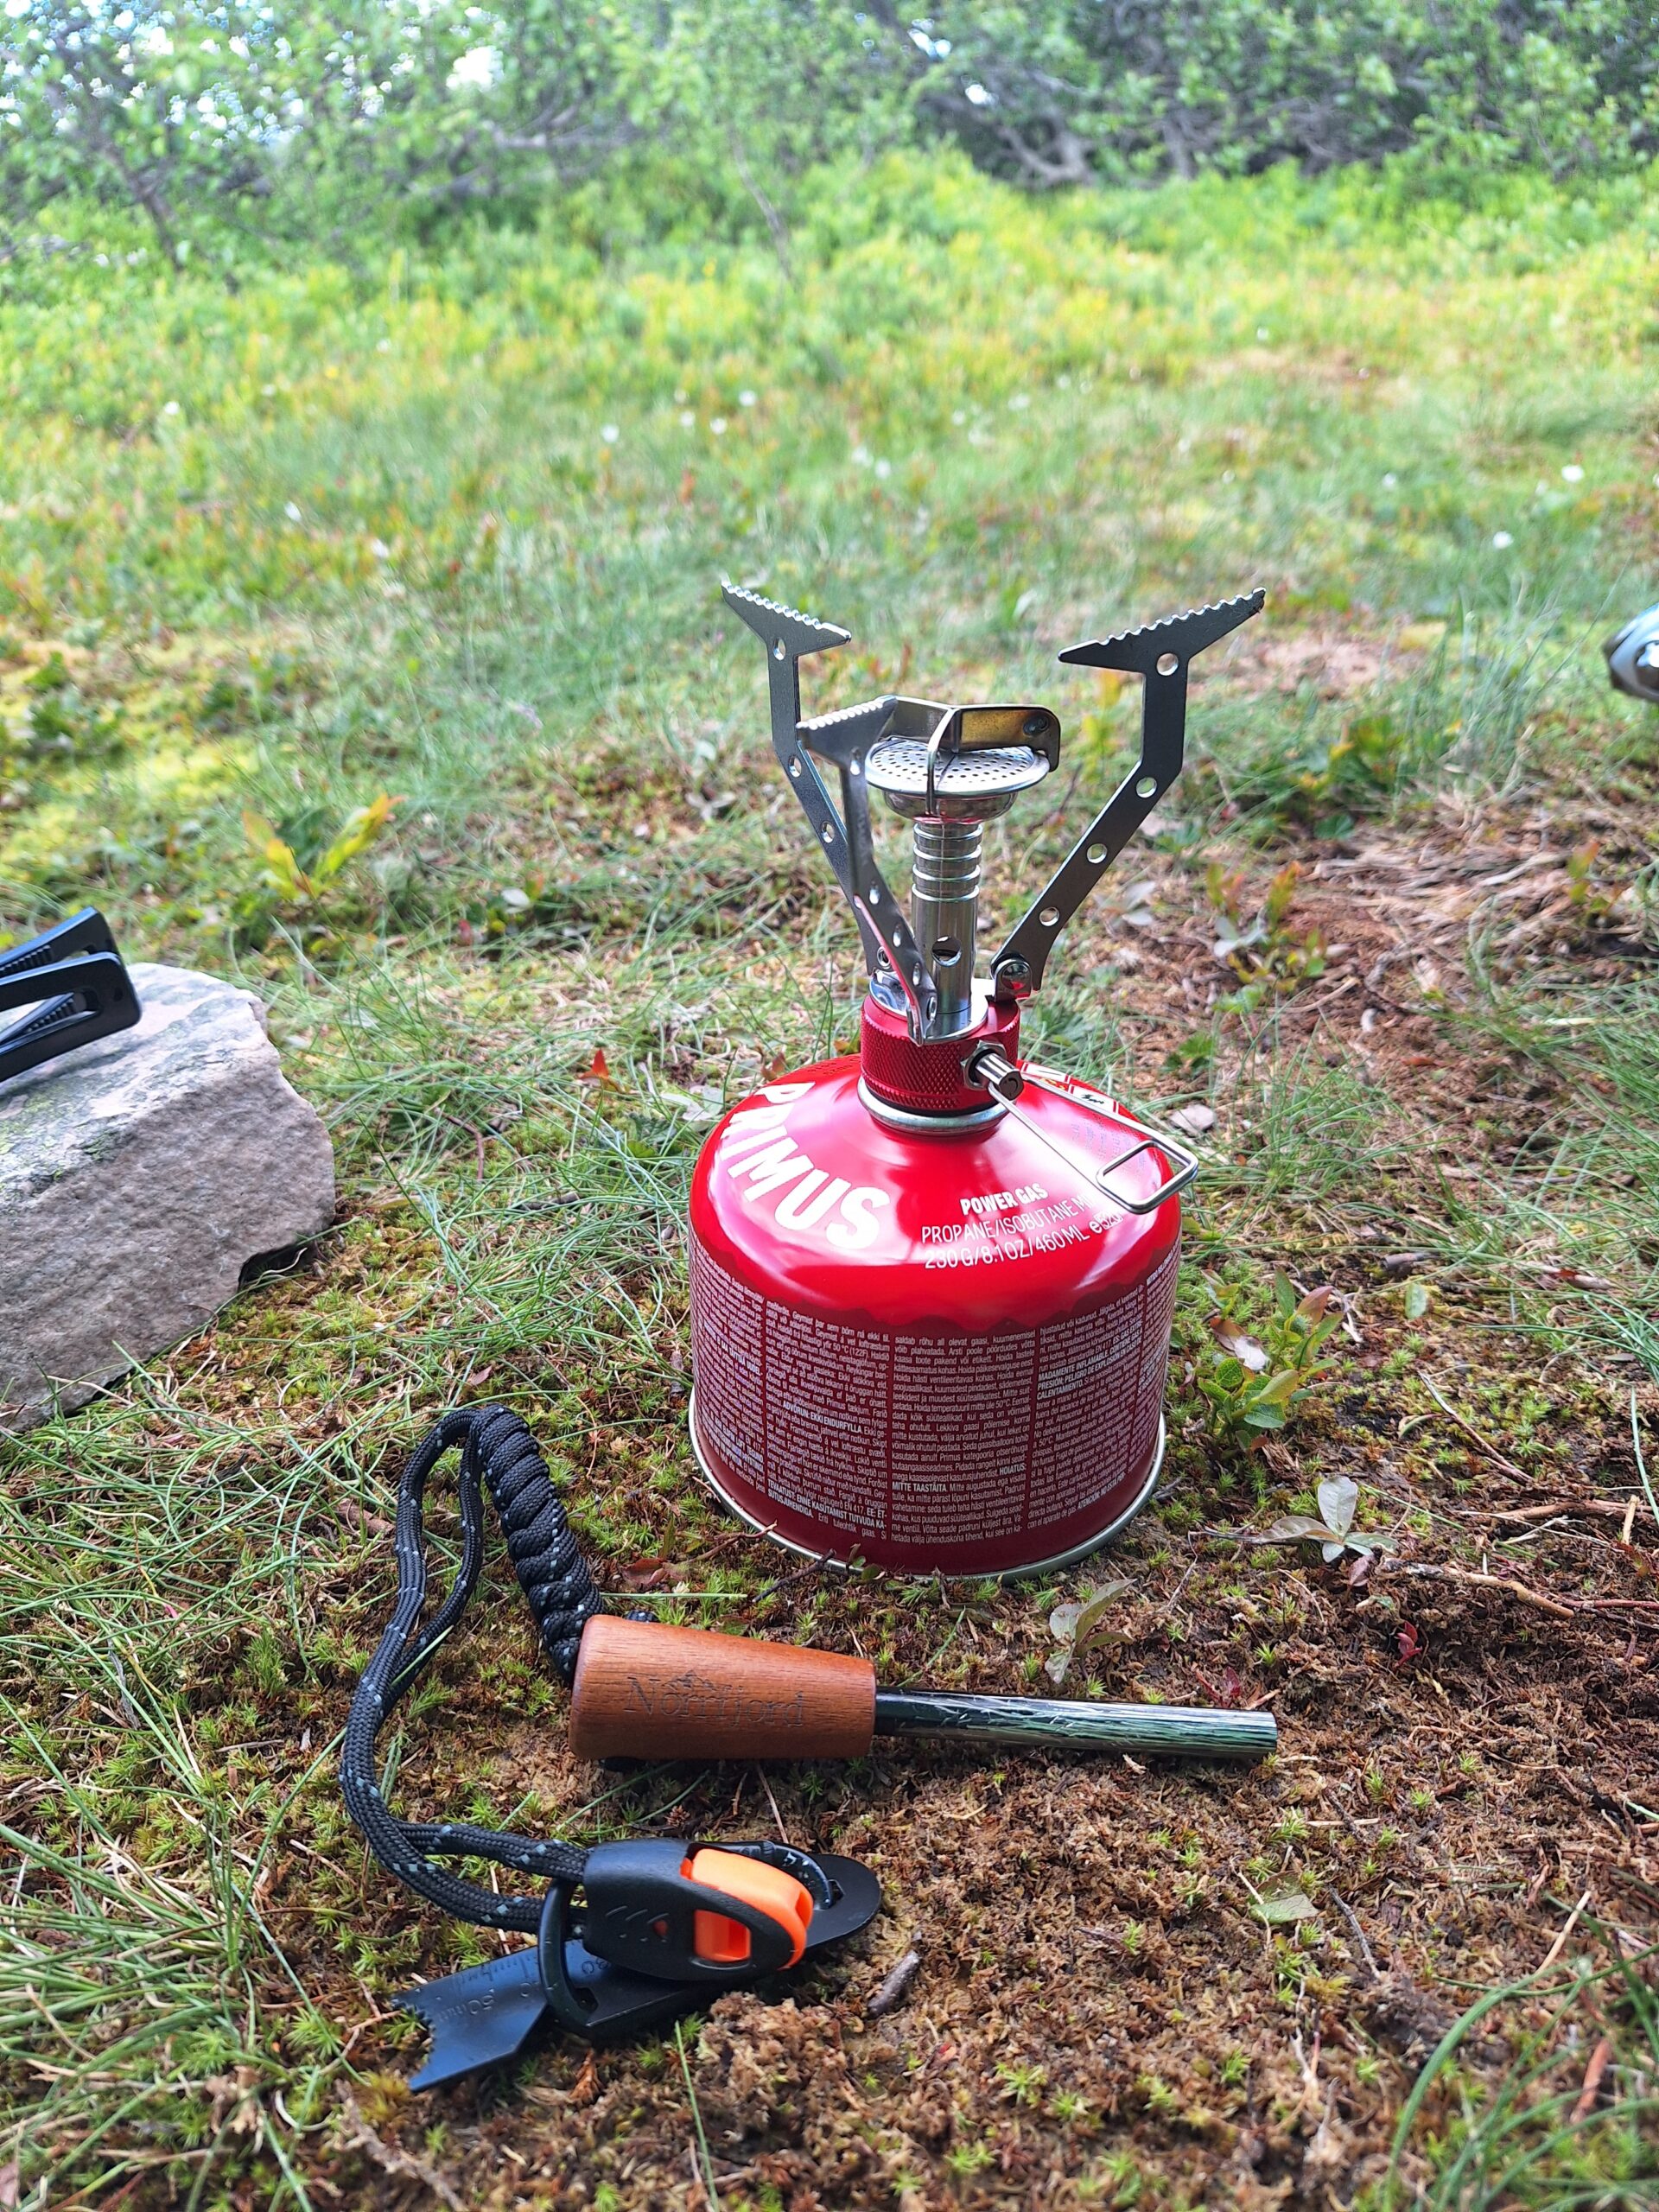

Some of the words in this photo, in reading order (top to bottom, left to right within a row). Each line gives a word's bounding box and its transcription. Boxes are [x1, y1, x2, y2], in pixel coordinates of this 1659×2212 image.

[719, 1082, 891, 1249] PRIMUS
[921, 1199, 1079, 1244] PROPANE/ISOBUTANE
[959, 1190, 1018, 1216] POWER
[1014, 1183, 1049, 1204] GAS
